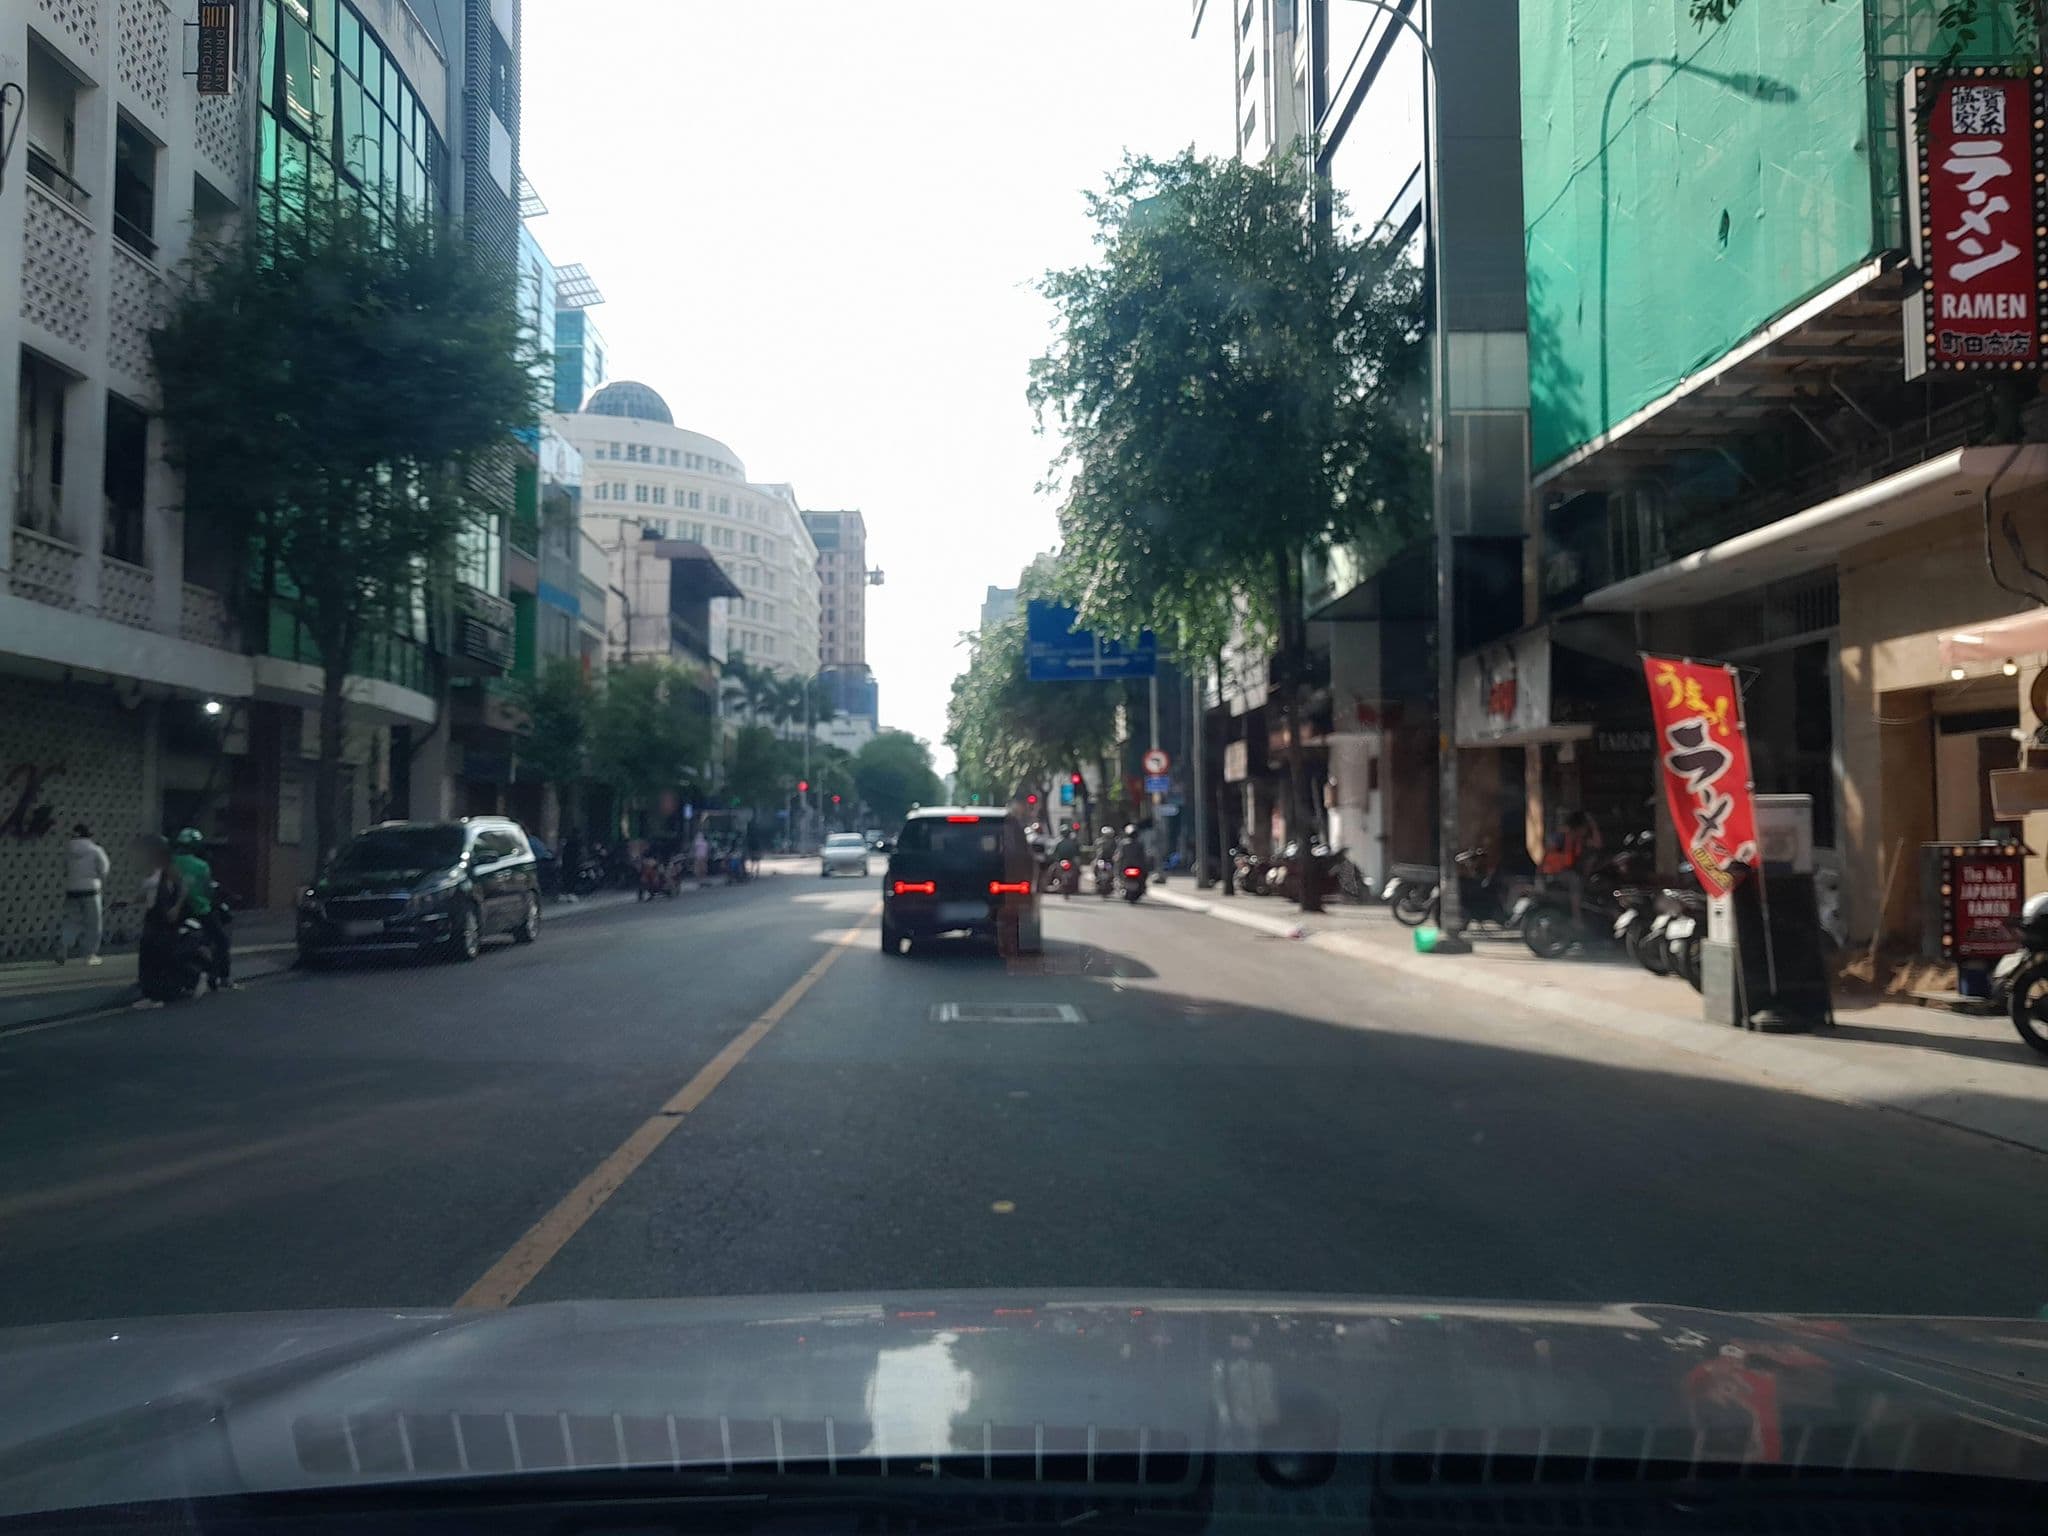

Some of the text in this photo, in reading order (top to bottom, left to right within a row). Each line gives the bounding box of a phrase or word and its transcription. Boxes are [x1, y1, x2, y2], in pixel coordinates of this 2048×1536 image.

[200, 39, 212, 90] KITCHEN
[216, 29, 225, 90] DRINKERY
[1942, 140, 2021, 283] ラーメン
[1941, 293, 2027, 319] RAMEN
[1963, 866, 2012, 882] The No.1
[1960, 883, 2017, 899] JAPANESE
[1967, 901, 2010, 917] RAMEN
